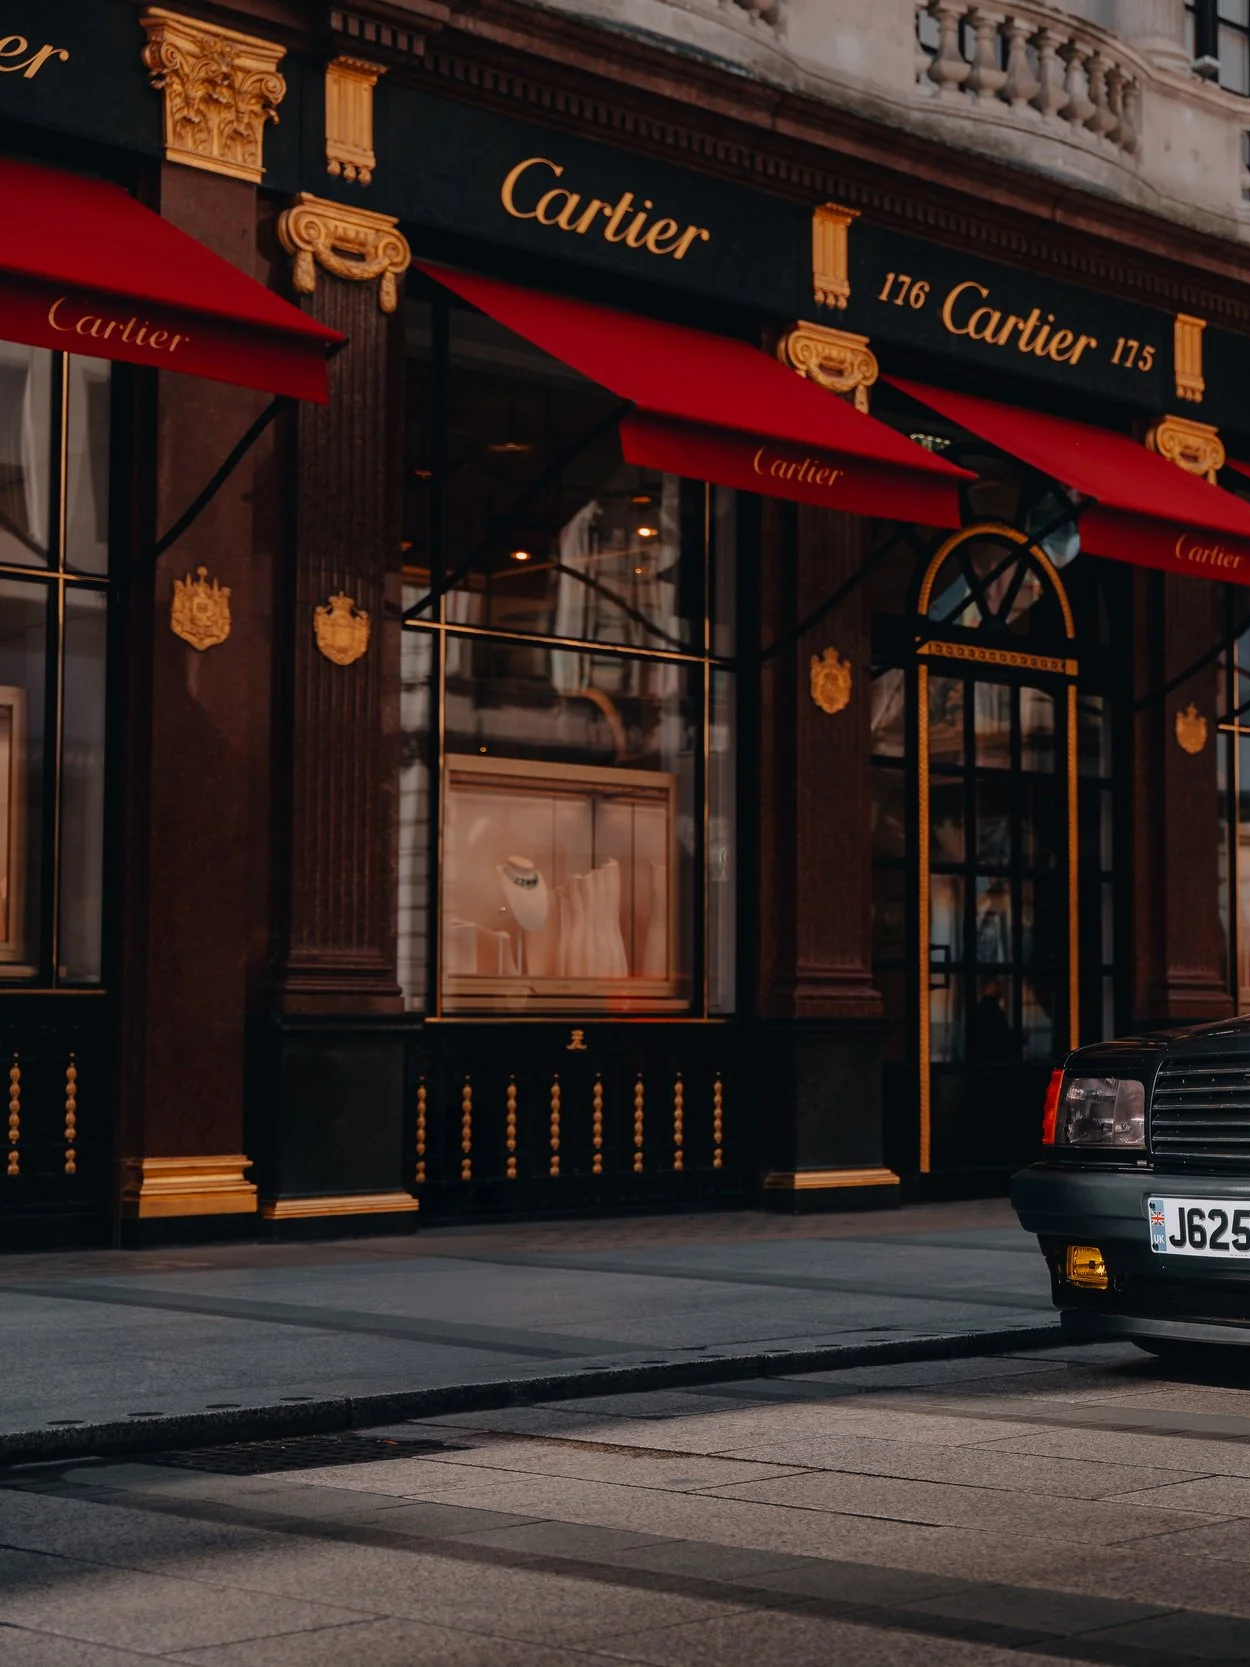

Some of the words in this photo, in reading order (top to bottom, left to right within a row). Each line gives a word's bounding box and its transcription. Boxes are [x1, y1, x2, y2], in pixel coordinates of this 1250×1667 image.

[501, 157, 711, 260] Cartier
[48, 296, 190, 352] Cartier
[878, 272, 931, 310] 176
[942, 280, 1098, 366] Cartier
[1111, 336, 1156, 372] 175
[753, 446, 844, 486] Cartier
[1175, 533, 1244, 569] Cartier
[1153, 1233, 1165, 1244] UK
